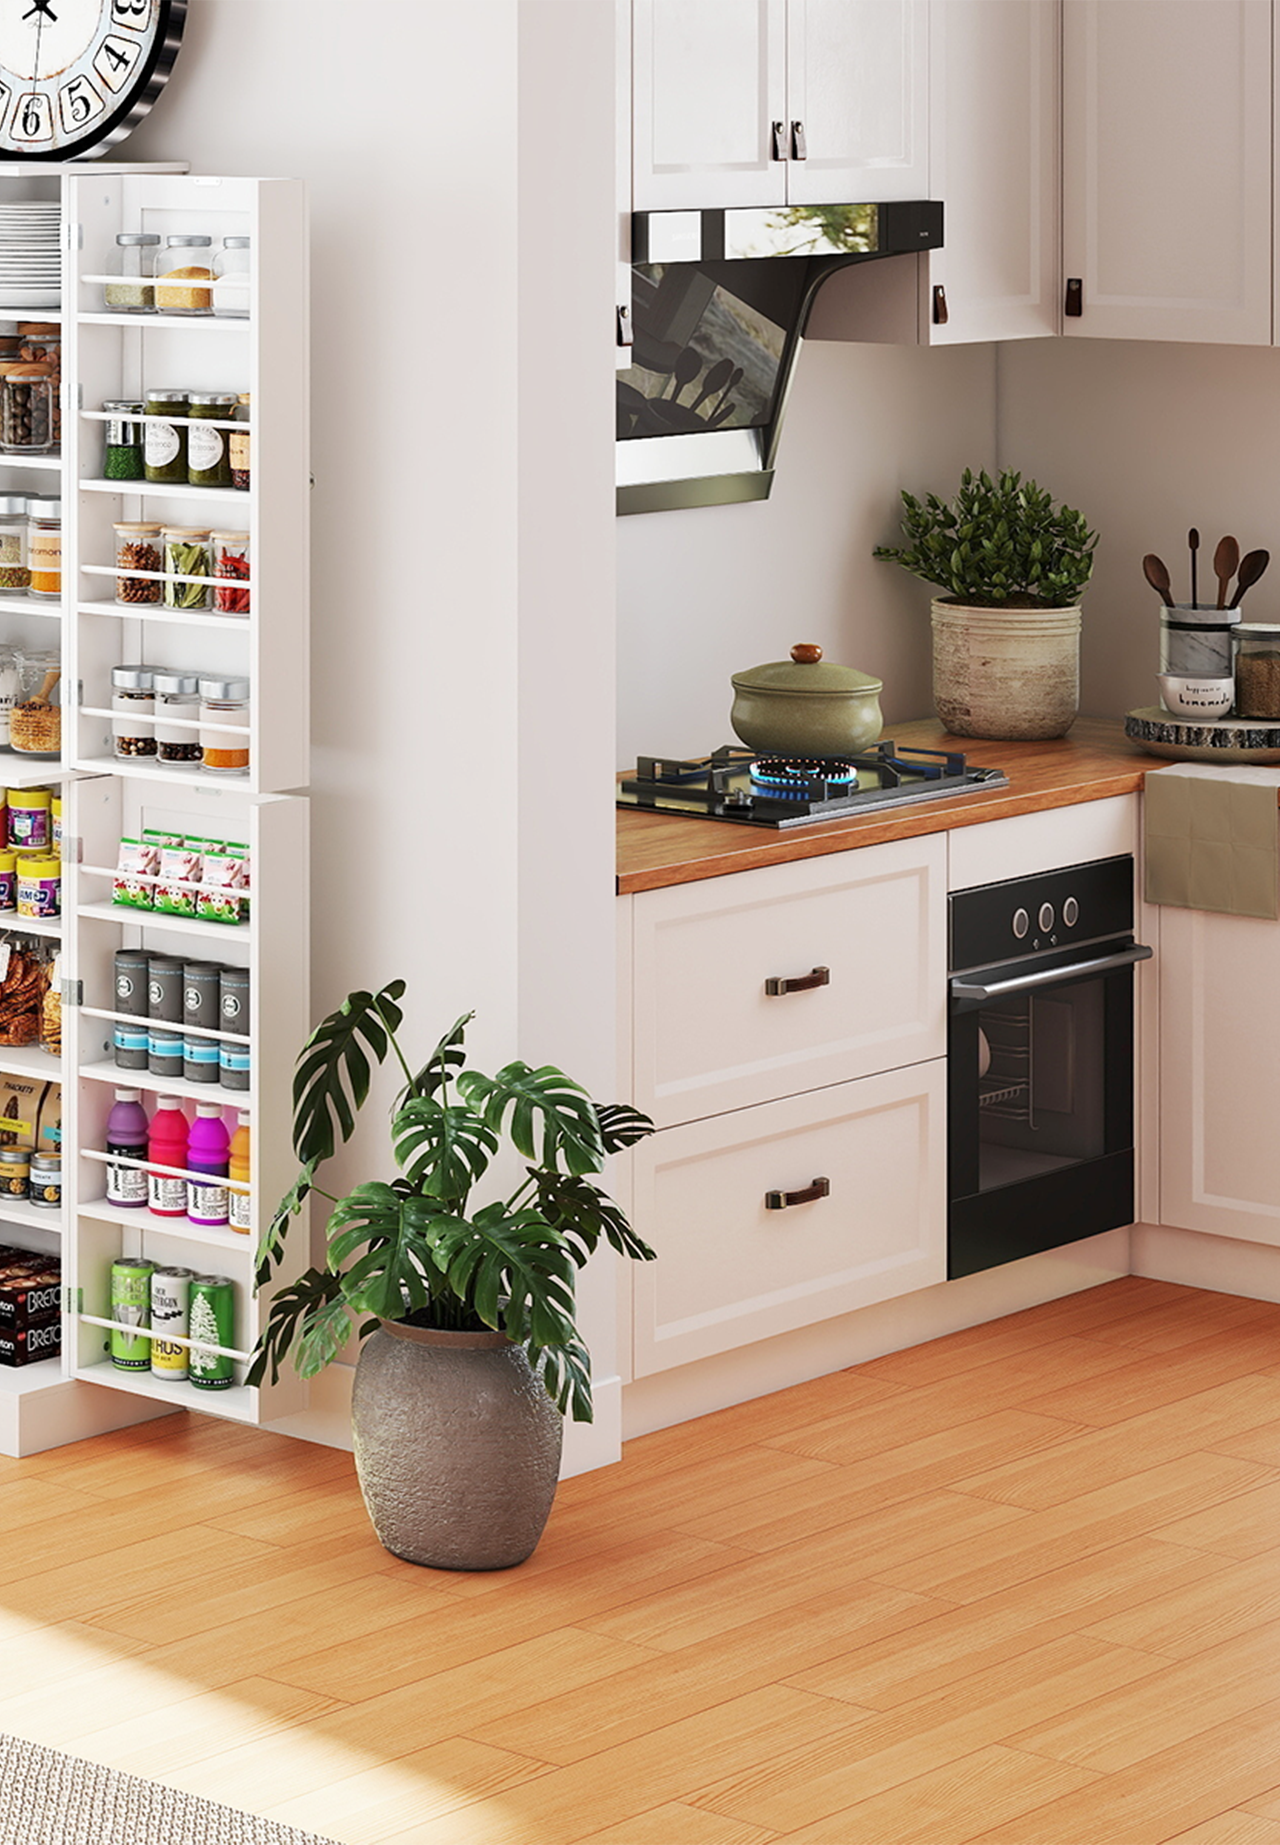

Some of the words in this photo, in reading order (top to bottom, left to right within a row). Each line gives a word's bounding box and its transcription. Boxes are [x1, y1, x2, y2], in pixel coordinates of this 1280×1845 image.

[104, 44, 130, 72] 4
[22, 97, 42, 136] 6
[68, 81, 90, 122] 5
